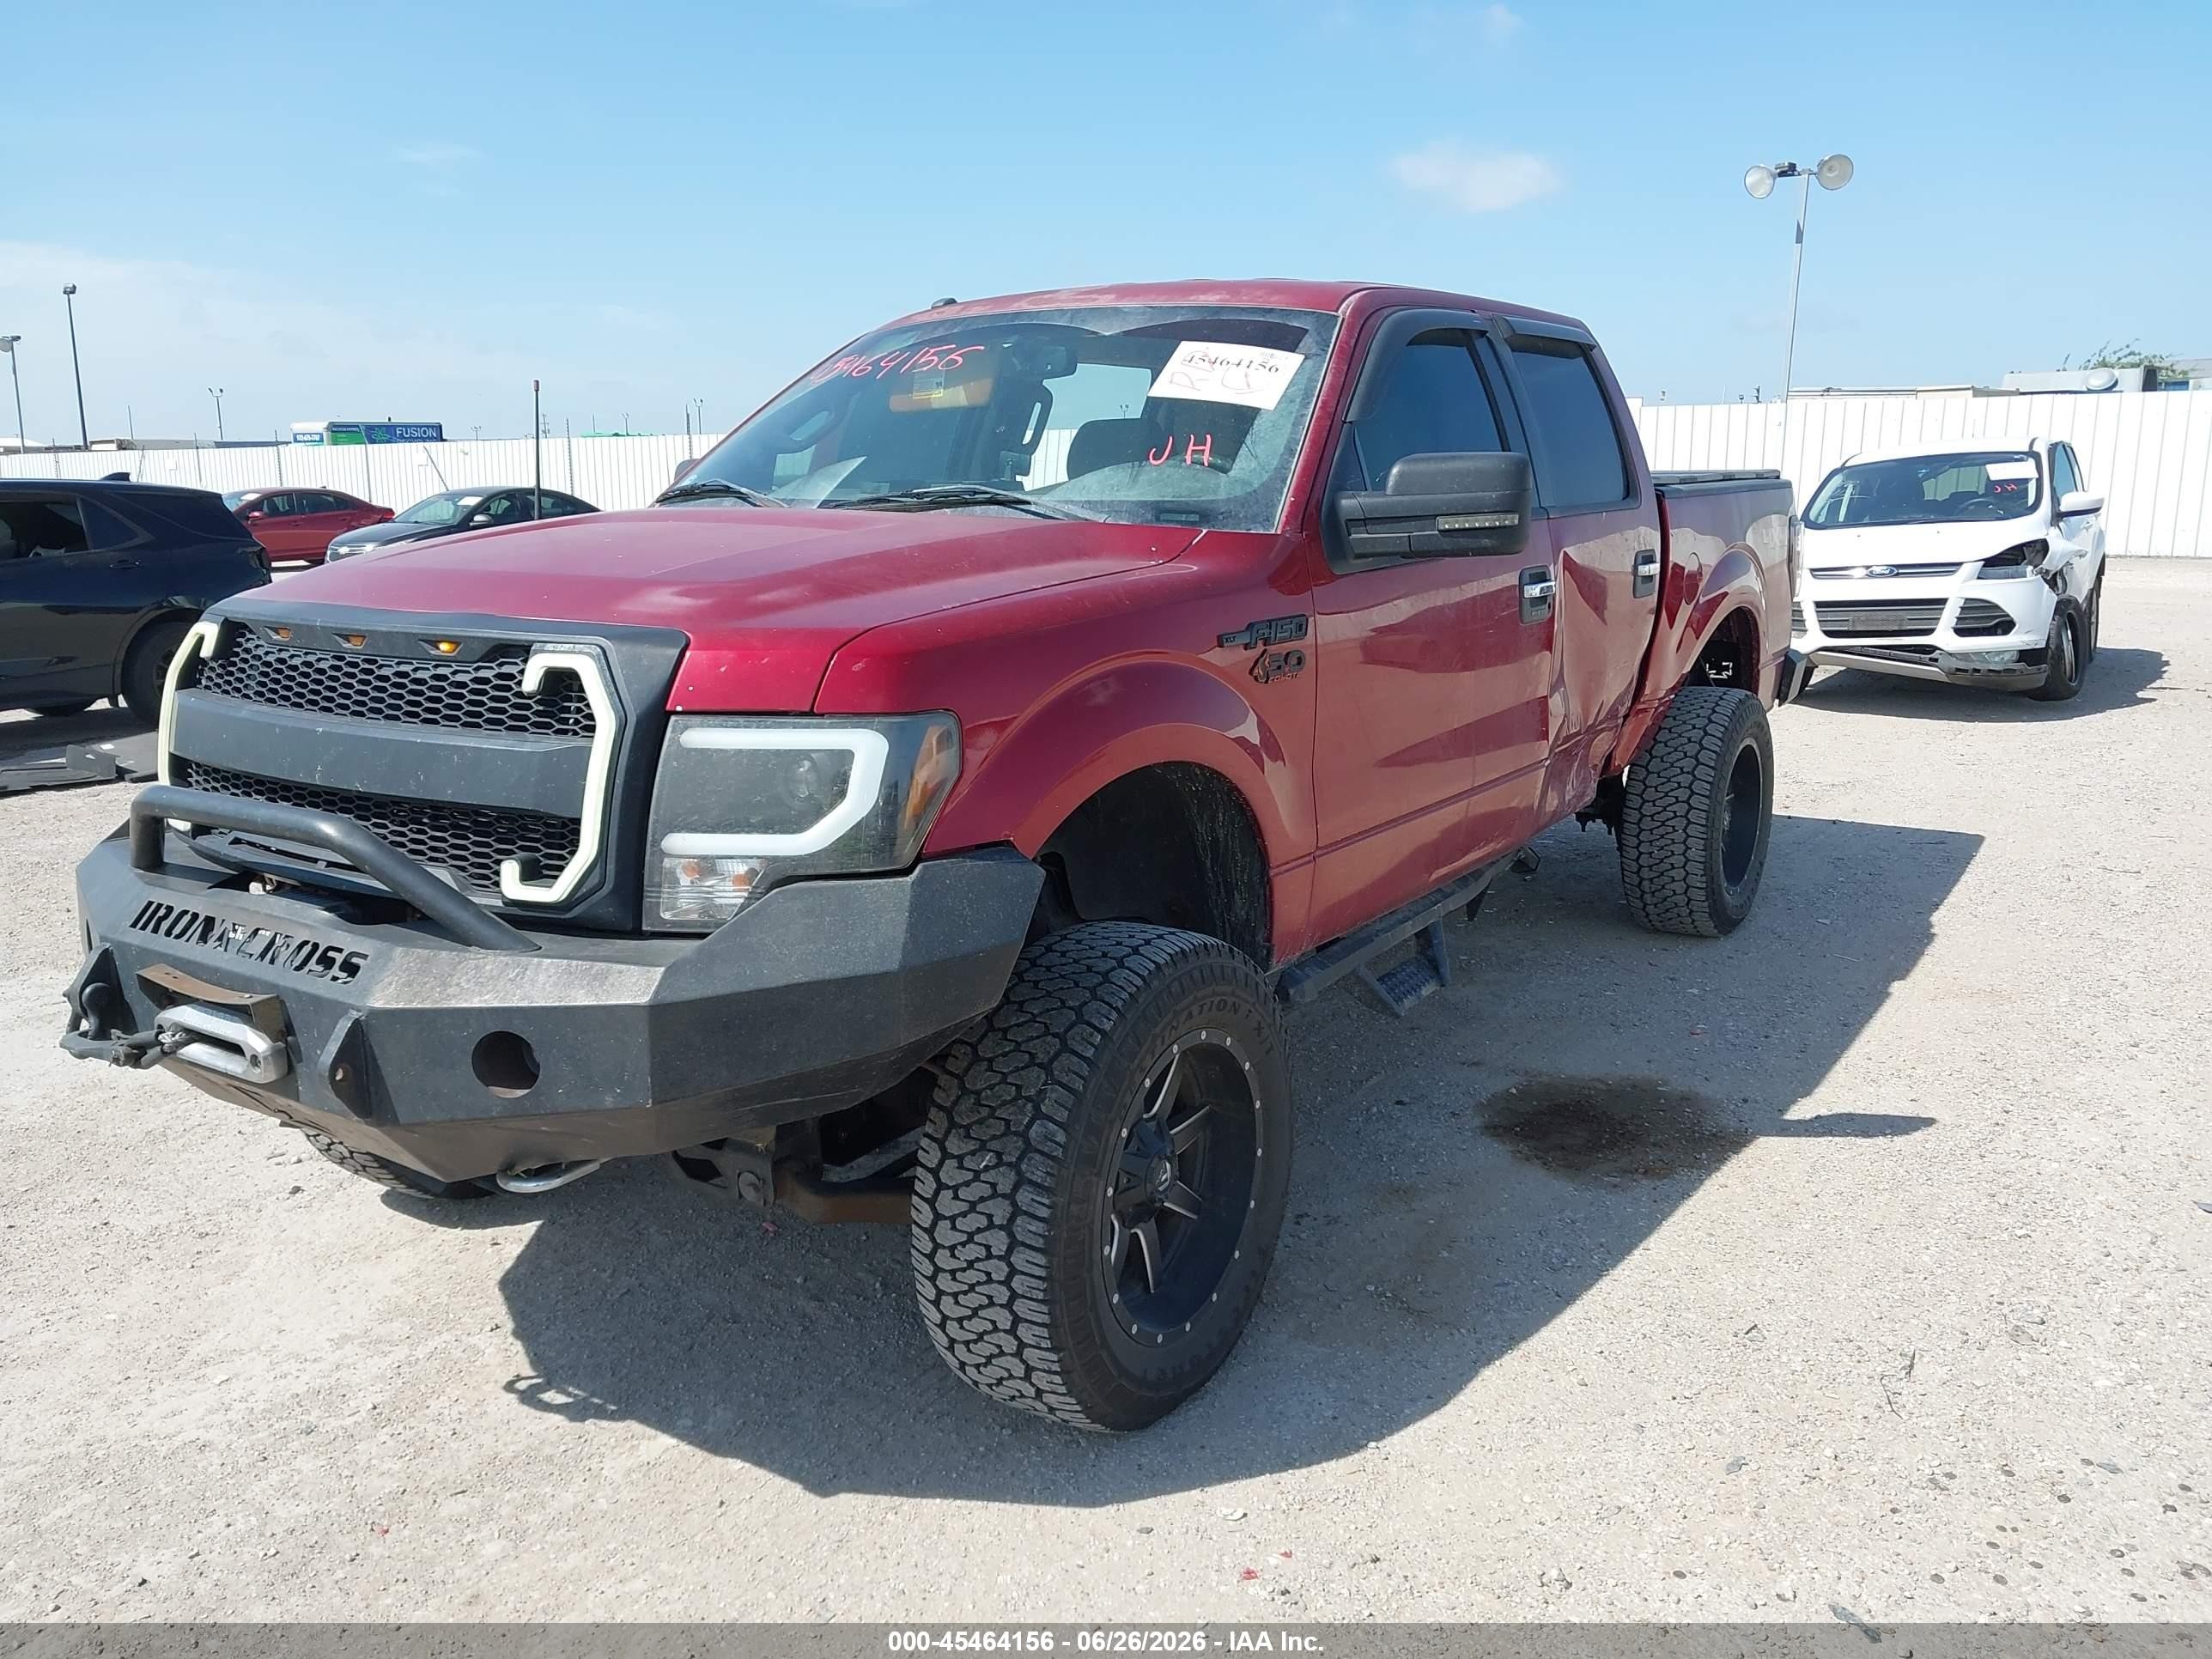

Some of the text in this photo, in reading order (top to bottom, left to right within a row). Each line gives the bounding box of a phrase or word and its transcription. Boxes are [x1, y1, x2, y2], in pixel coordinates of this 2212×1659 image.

[396, 427, 437, 438] FUSION
[1249, 615, 1308, 648] F-150
[129, 900, 369, 985] IRON CROSS
